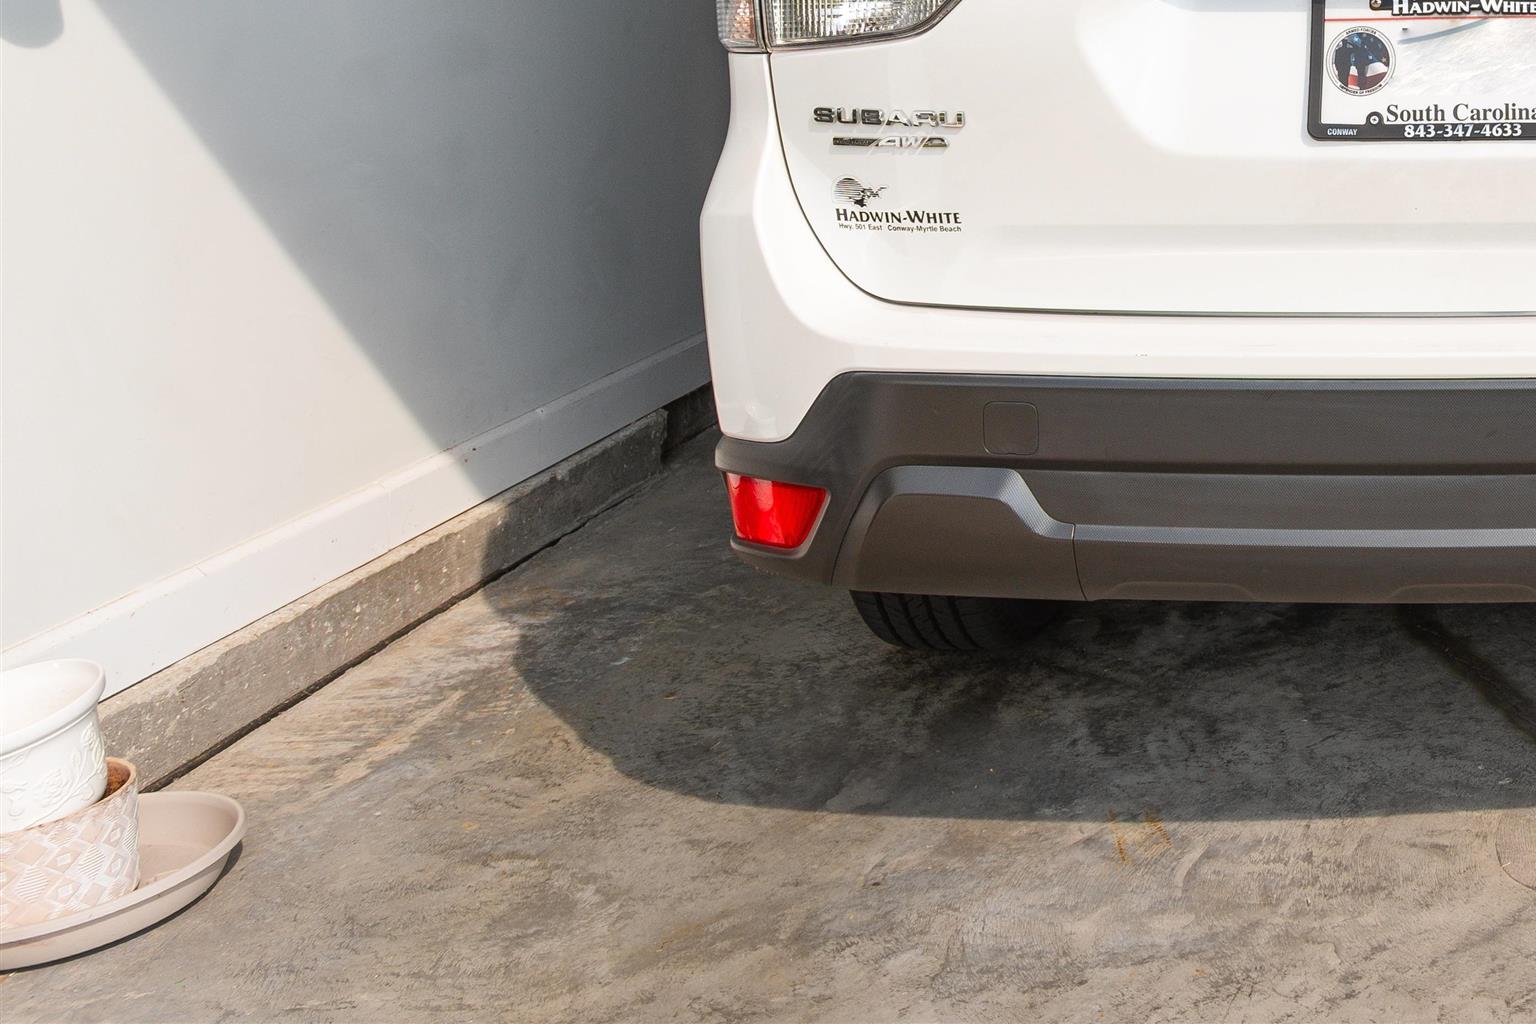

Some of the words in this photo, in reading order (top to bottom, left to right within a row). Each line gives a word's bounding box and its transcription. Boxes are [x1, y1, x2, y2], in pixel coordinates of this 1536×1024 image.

[813, 106, 965, 128] SUBARU
[1386, 104, 1446, 123] South
[1327, 128, 1358, 136] CONWAY
[1404, 123, 1522, 137] 843-347-4633
